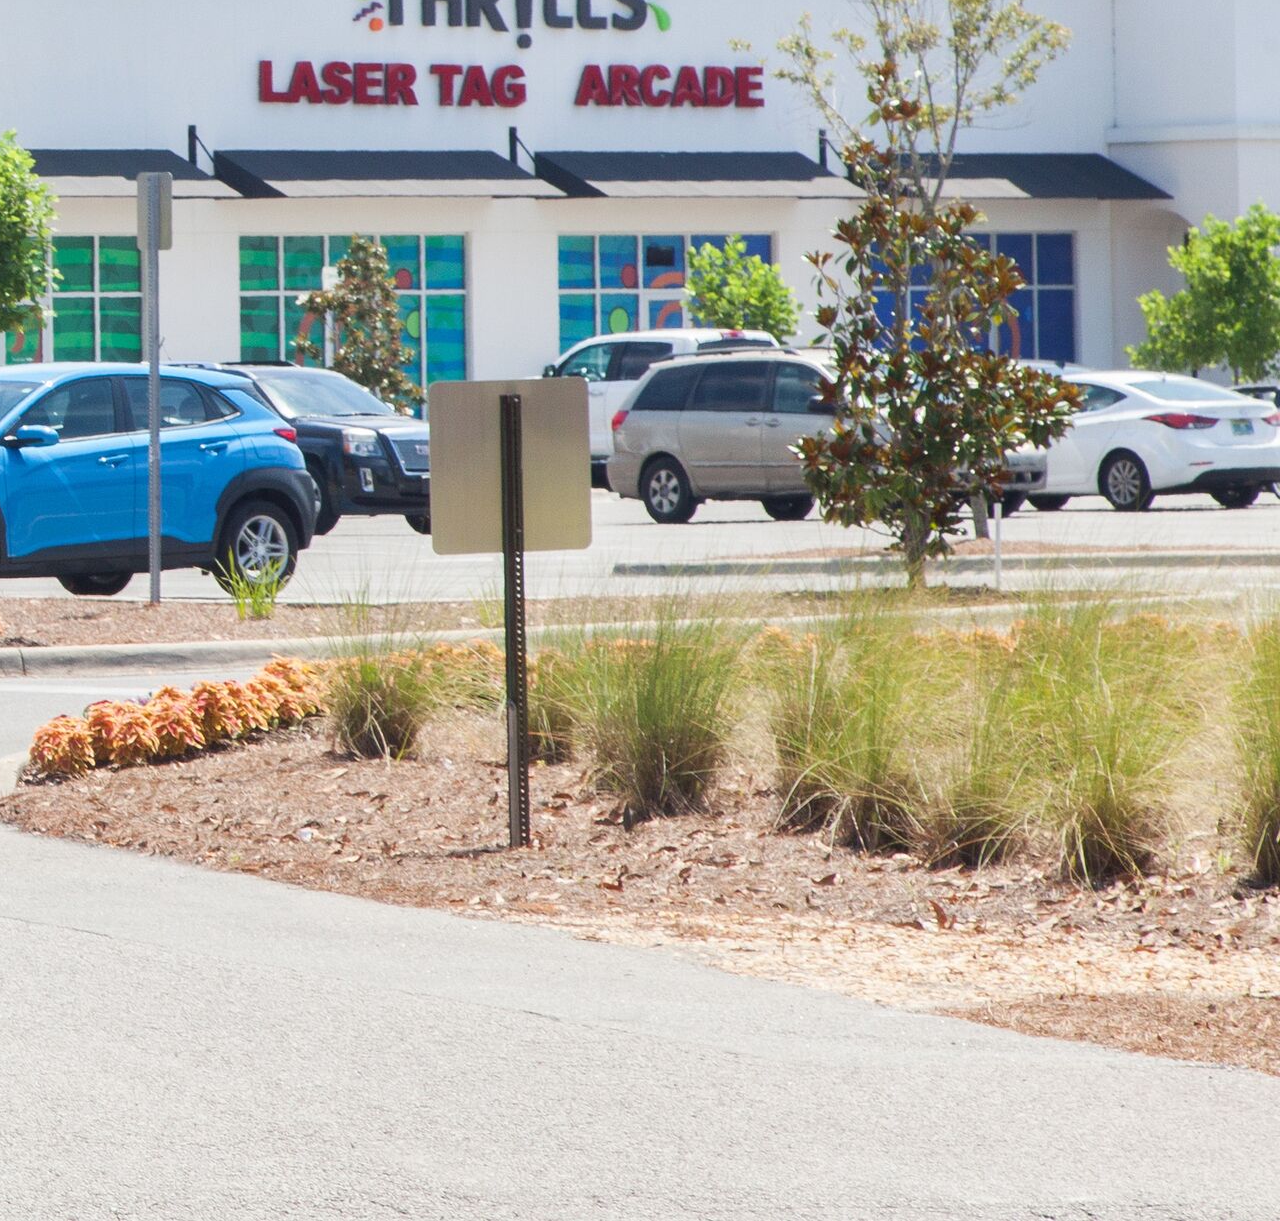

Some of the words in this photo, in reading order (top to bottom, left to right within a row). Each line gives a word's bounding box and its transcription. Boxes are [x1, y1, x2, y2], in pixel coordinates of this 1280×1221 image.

[258, 60, 419, 106] LASER
[430, 64, 527, 108] TAG
[573, 64, 765, 108] ARCADE
